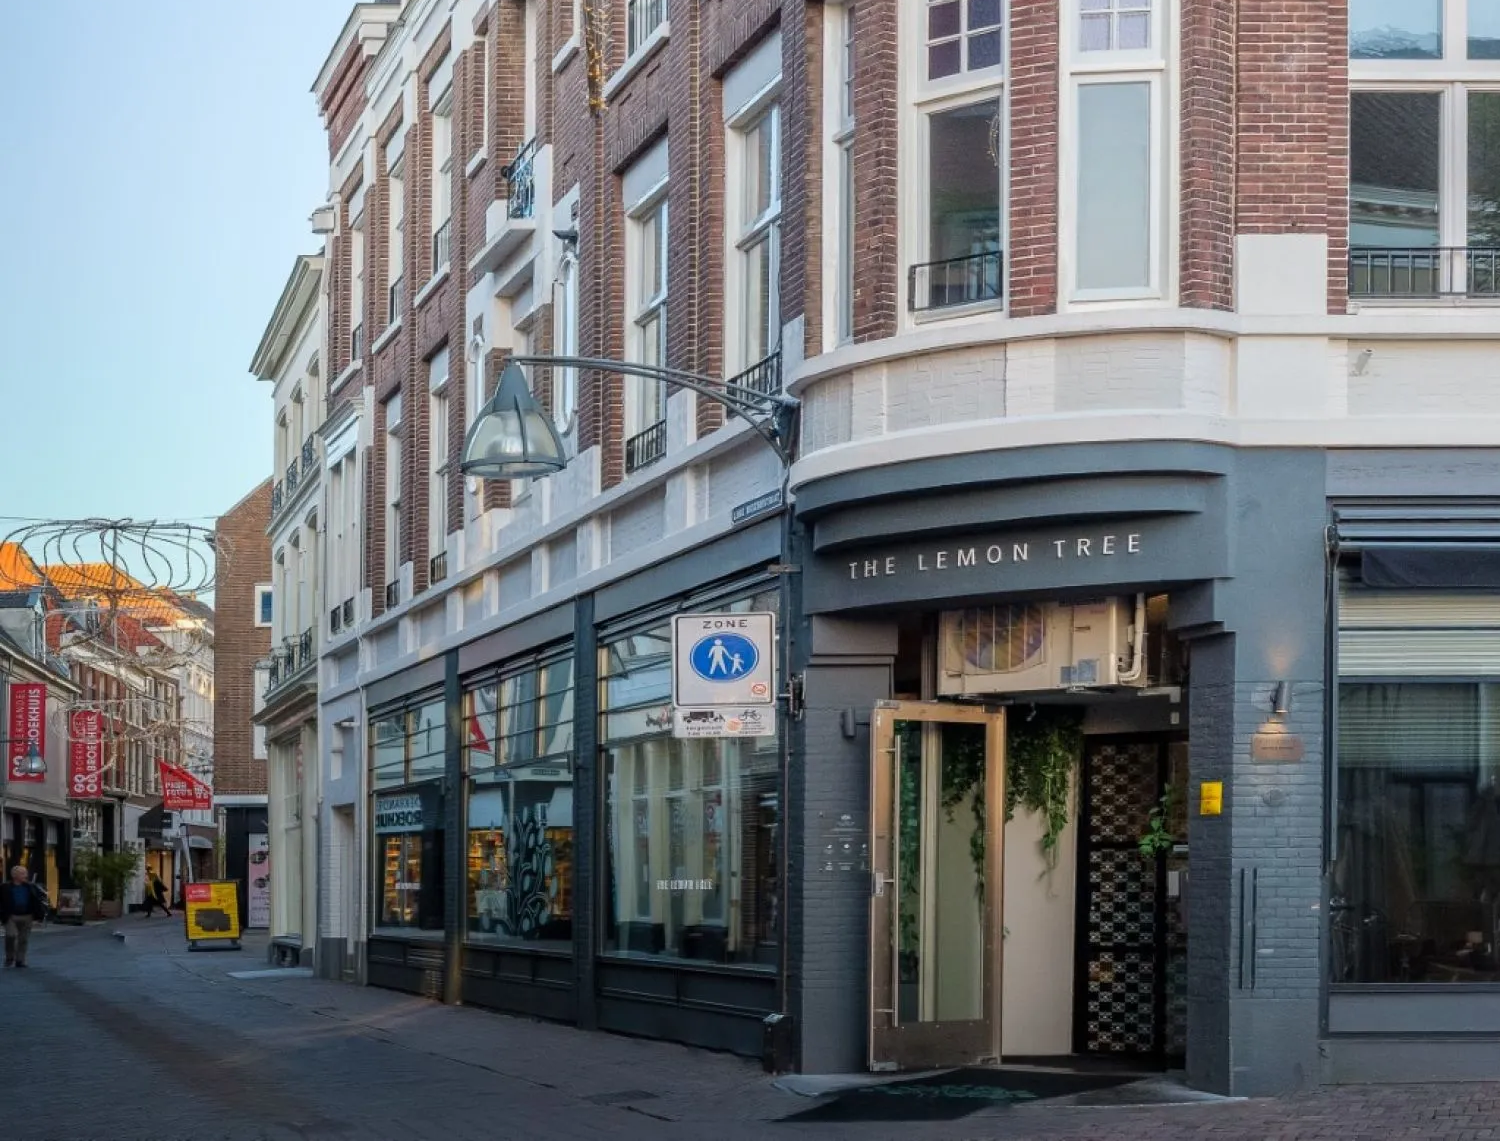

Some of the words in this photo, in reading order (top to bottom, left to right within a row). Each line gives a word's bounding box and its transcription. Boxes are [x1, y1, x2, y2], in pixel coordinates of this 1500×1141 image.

[850, 557, 896, 580] THE
[918, 543, 1029, 571] LEMON
[1053, 534, 1141, 559] TREE
[702, 619, 748, 629] ZONE
